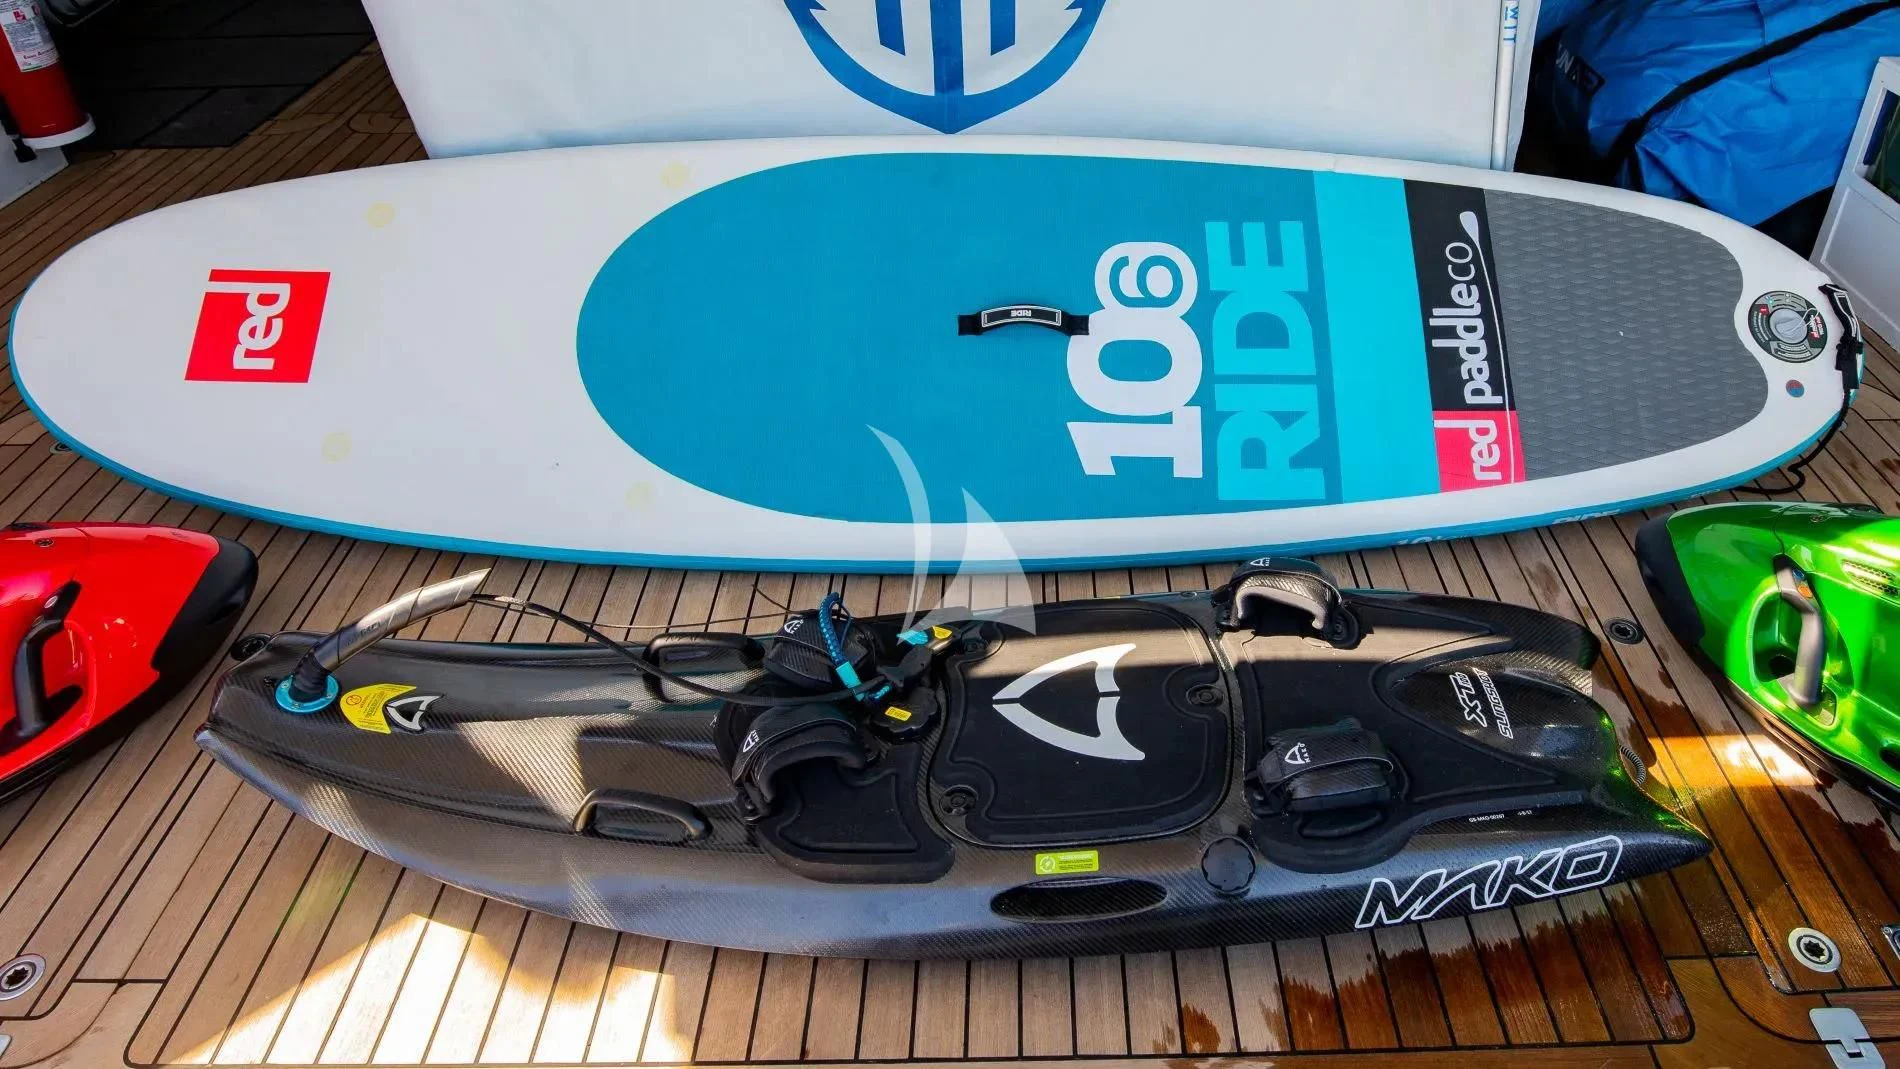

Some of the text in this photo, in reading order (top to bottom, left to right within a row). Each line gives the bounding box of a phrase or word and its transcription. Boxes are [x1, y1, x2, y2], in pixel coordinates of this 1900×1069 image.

[208, 281, 292, 370] red
[1010, 309, 1032, 318] RIDE
[1204, 220, 1326, 500] RIDE
[1433, 419, 1503, 481] red
[1470, 665, 1514, 740] SLINGSHOT
[1354, 834, 1623, 929] MAKO
